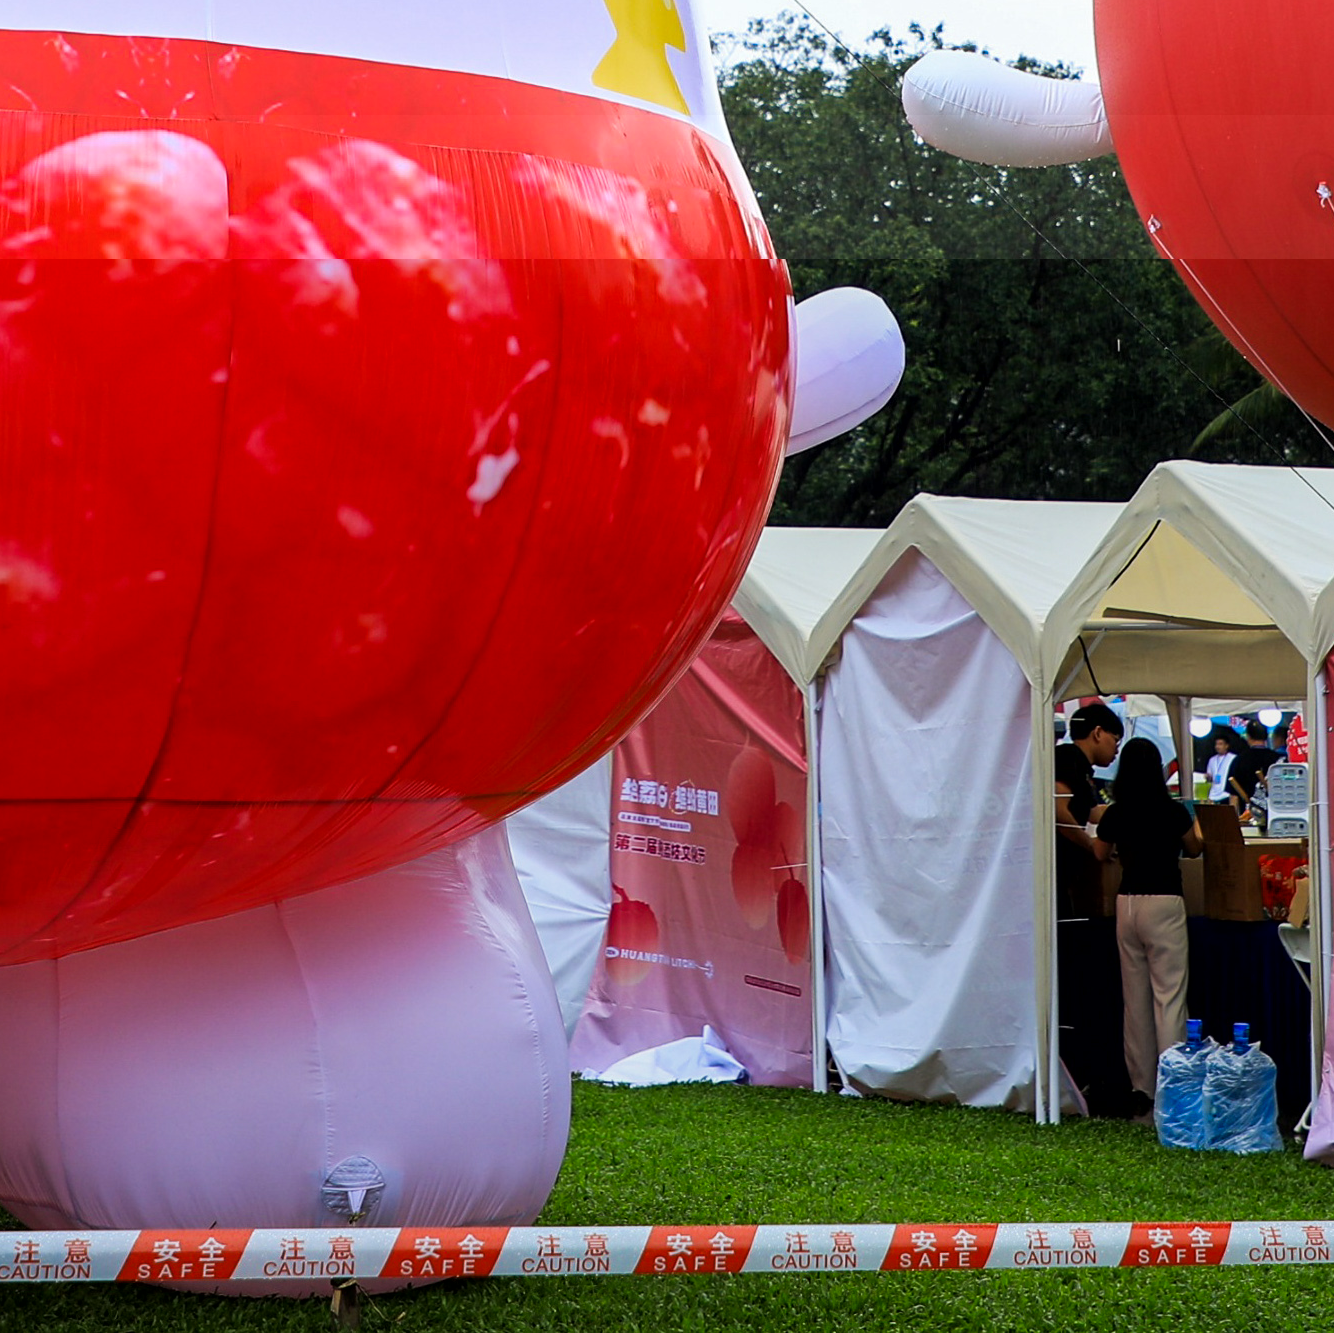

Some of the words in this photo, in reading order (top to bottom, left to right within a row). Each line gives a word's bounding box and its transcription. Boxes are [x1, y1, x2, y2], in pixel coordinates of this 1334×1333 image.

[14, 1238, 92, 1265] 注意
[153, 1237, 227, 1263] 安全
[280, 1235, 355, 1261] 注意
[414, 1234, 485, 1259] 安全
[537, 1233, 609, 1257] 注意
[667, 1231, 735, 1256] 安全
[785, 1230, 857, 1254] 注意
[911, 1228, 979, 1253] 安全
[1026, 1228, 1095, 1252] 注意
[1148, 1226, 1213, 1248] 安全
[1261, 1225, 1329, 1247] 注意
[138, 1263, 216, 1279] SAFE
[263, 1260, 355, 1276] CAUTION
[400, 1259, 476, 1275] SAFE
[521, 1257, 610, 1272] CAUTION
[654, 1255, 727, 1271] SAFE
[771, 1254, 857, 1269] CAUTION
[899, 1252, 971, 1268] SAFE
[1013, 1250, 1097, 1266] CAUTION
[1138, 1248, 1207, 1264] SAFE
[1248, 1246, 1329, 1262] CAUTION
